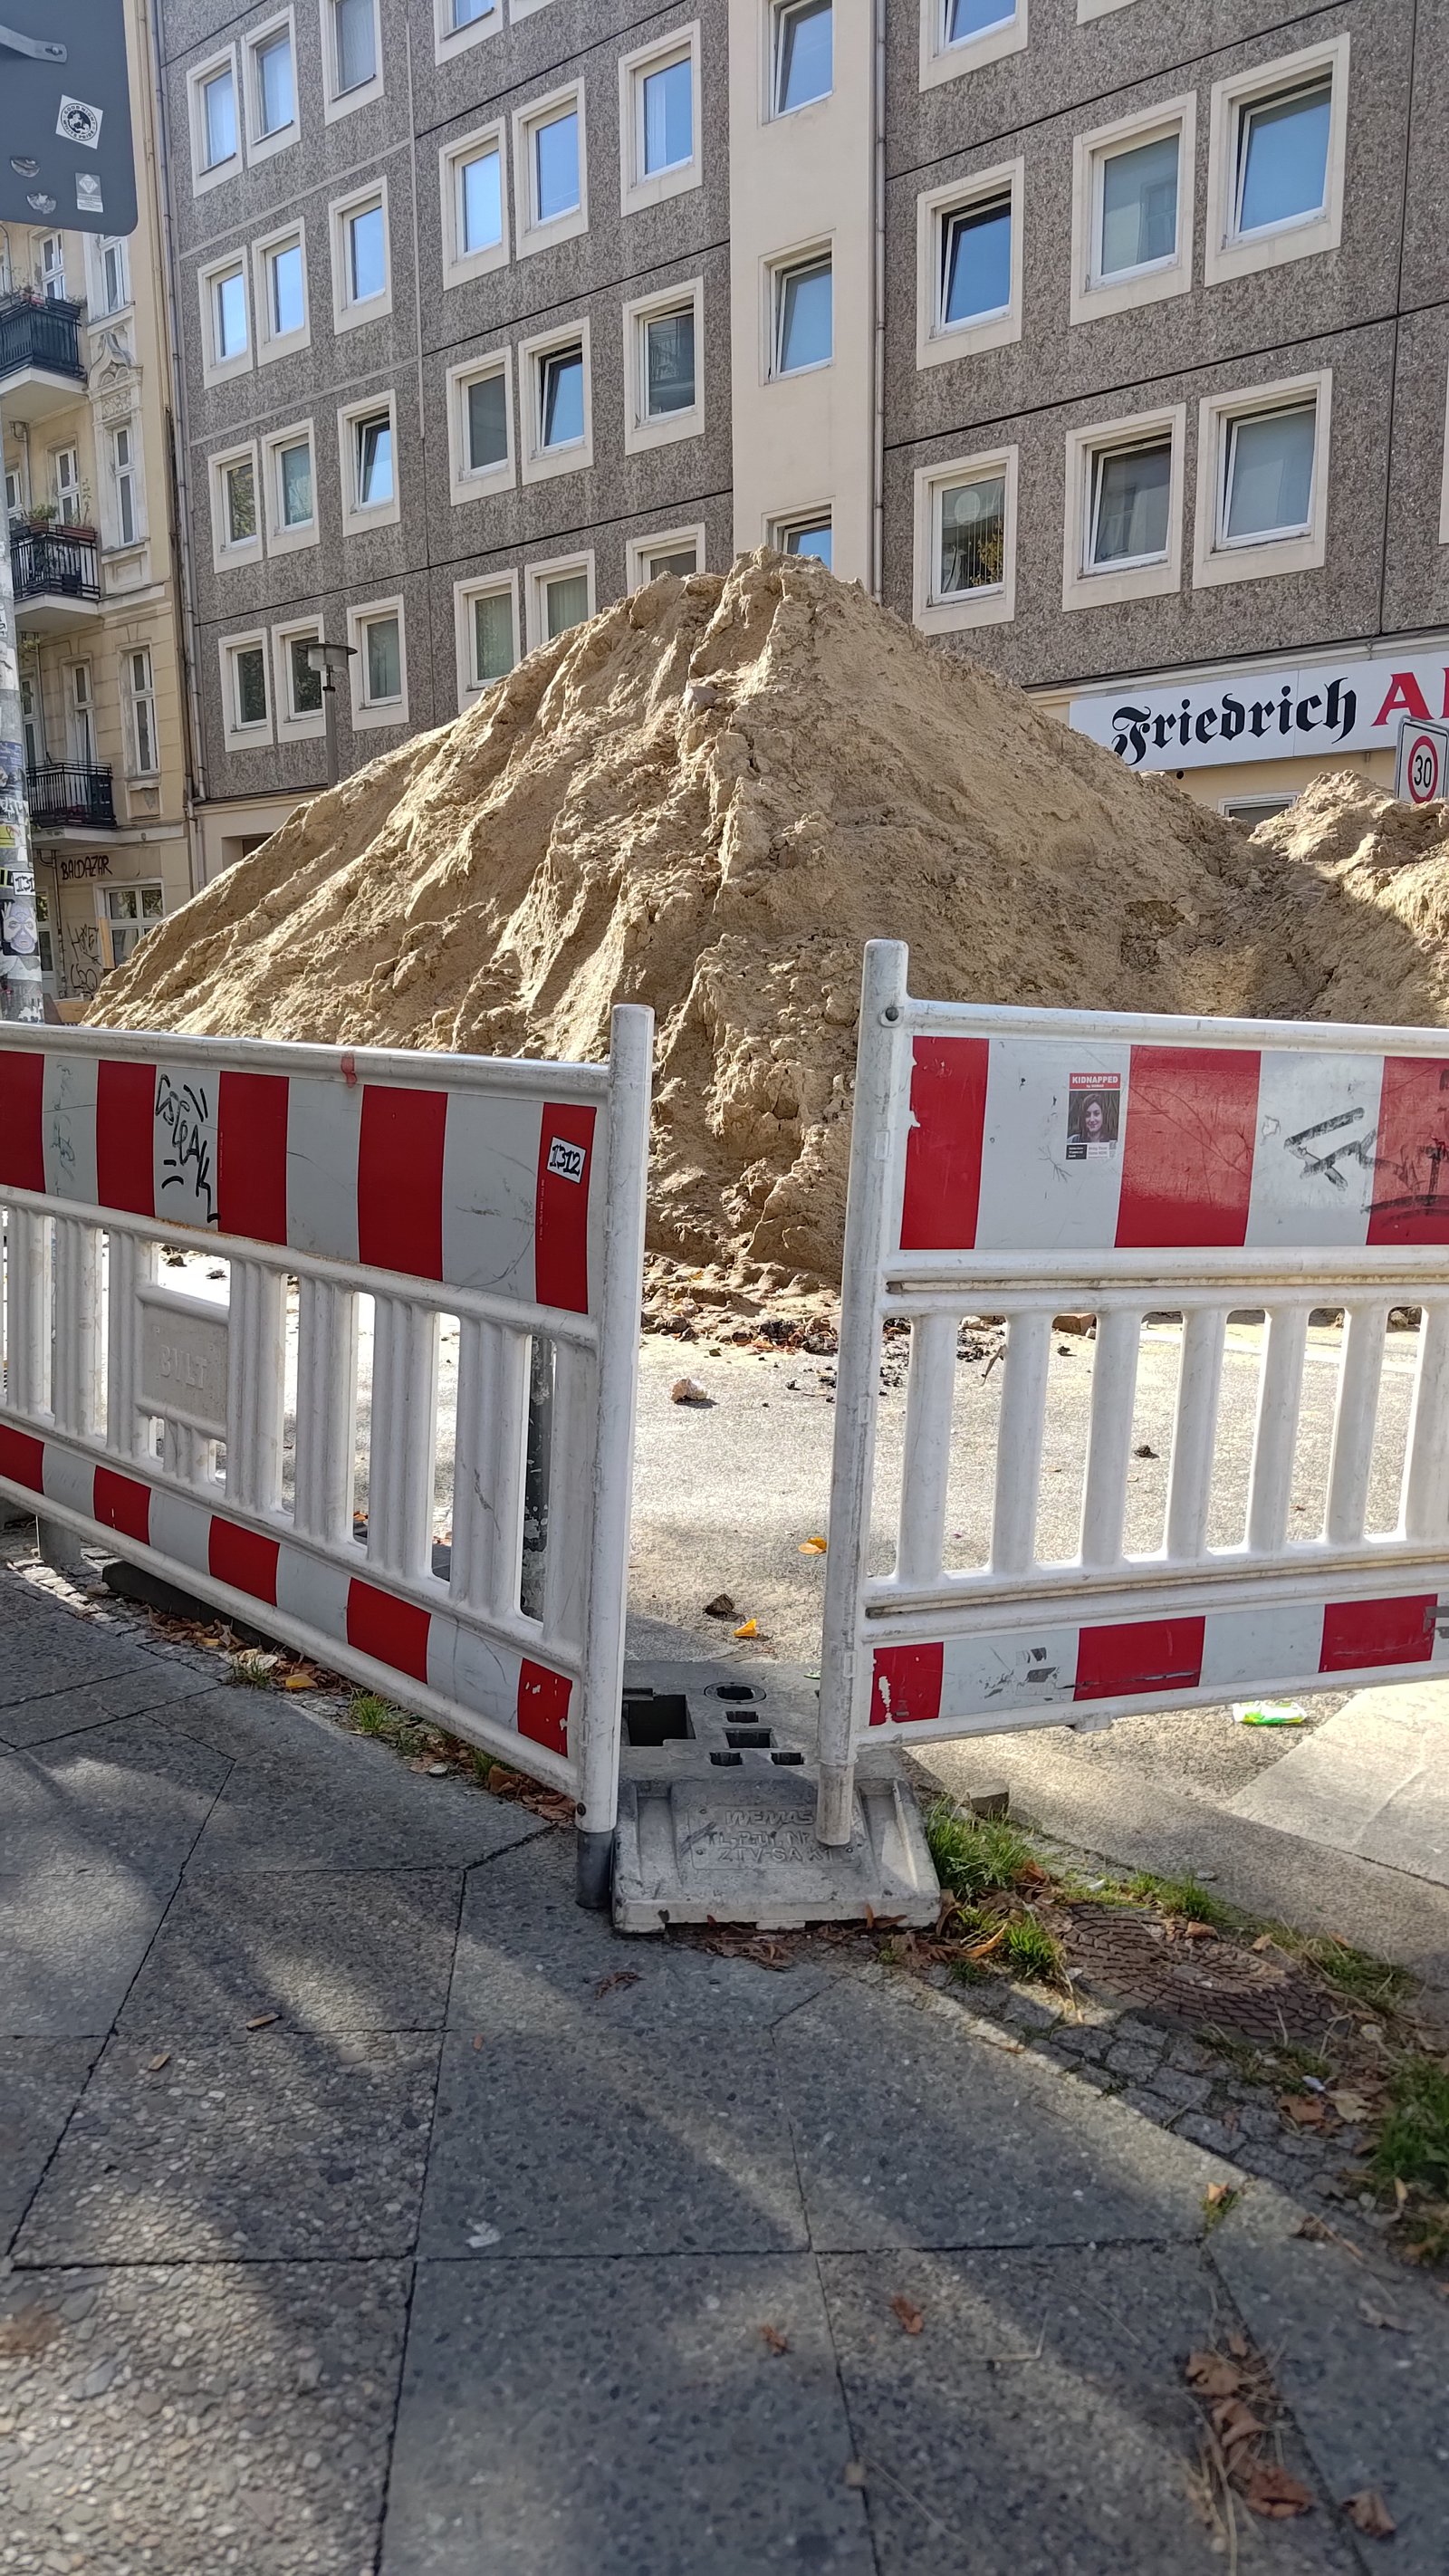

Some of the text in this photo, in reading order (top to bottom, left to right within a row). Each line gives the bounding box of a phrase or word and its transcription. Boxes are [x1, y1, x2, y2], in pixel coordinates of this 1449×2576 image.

[1111, 677, 1358, 766] Friedrich
[1414, 755, 1433, 788] 30
[61, 854, 113, 880] BALDAZAR
[1071, 1075, 1118, 1084] KIDNAPPED
[550, 1144, 581, 1177] 1312
[725, 1810, 815, 1826] WEMAS
[718, 1846, 803, 1863] ZTV-SA
